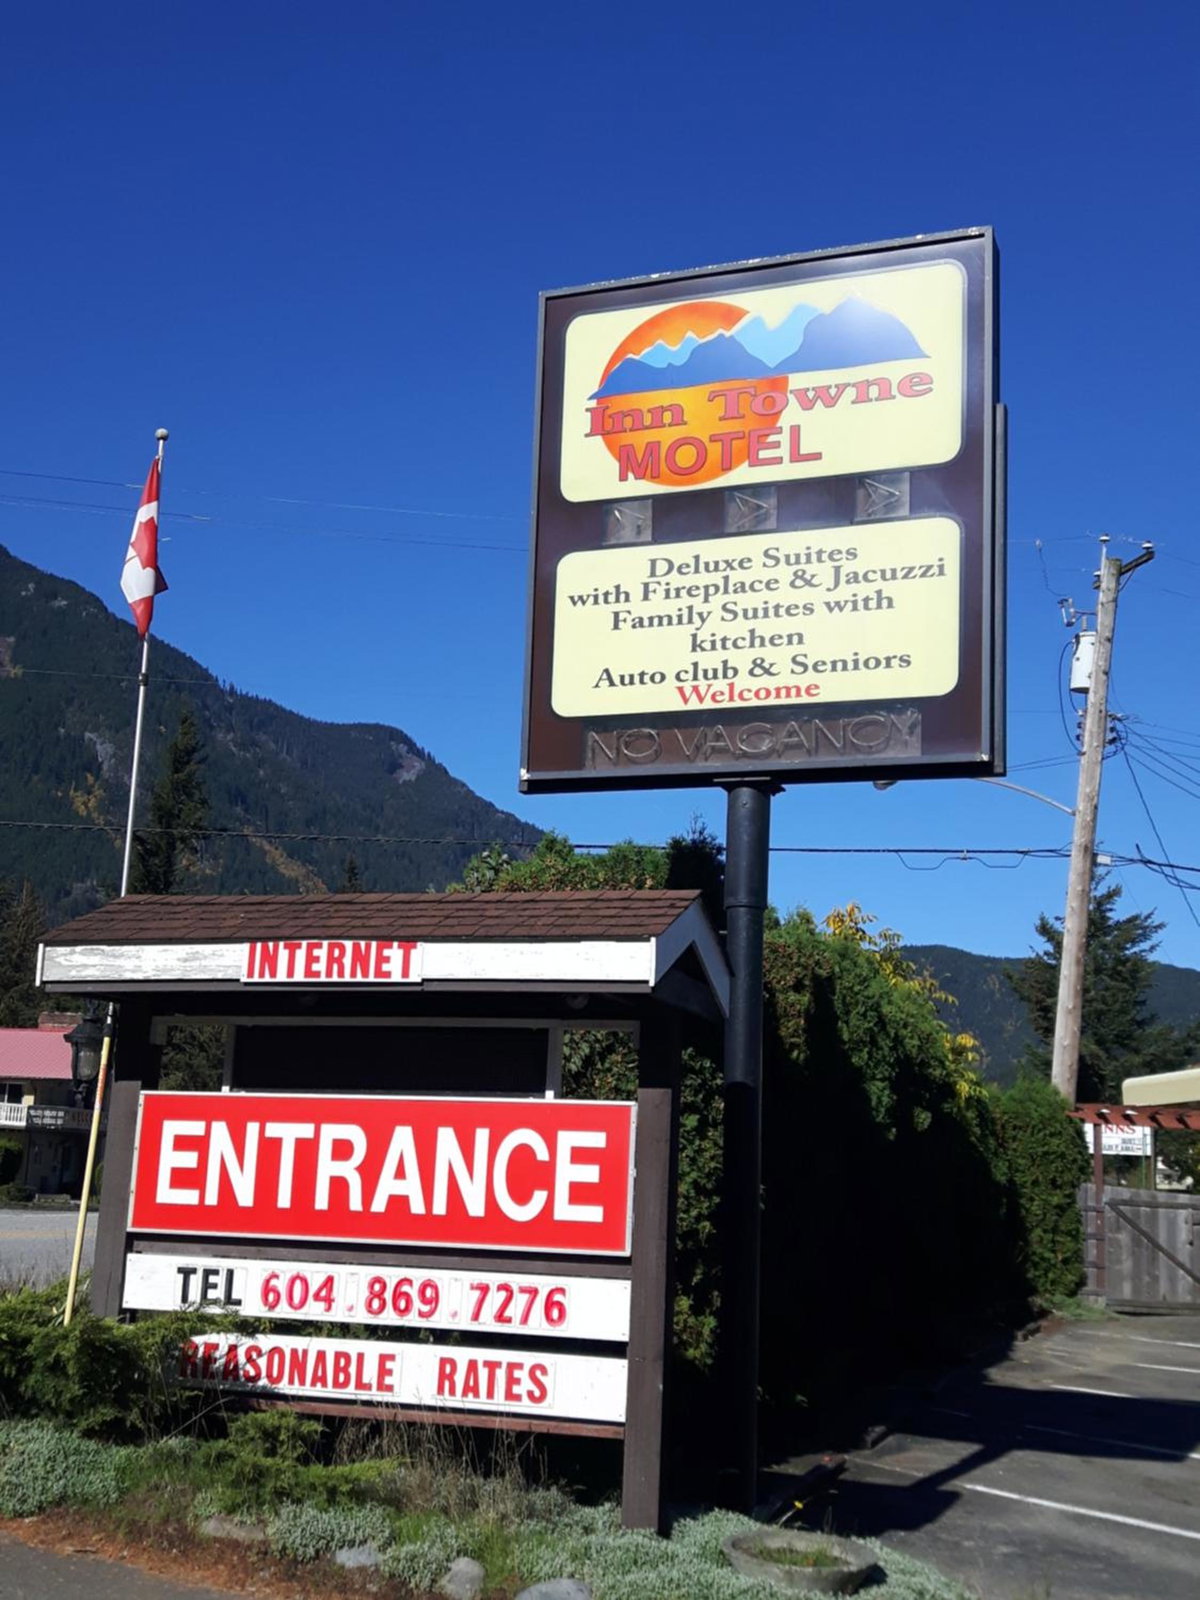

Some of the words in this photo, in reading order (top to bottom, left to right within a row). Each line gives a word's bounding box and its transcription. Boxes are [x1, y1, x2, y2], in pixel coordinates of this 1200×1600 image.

[584, 403, 687, 437] Inn
[707, 371, 935, 422] Towne
[618, 424, 822, 482] MOTEL
[568, 585, 631, 607] with
[640, 573, 780, 603] Fireplace
[789, 568, 822, 589] &
[826, 557, 947, 592] Jacuzzi
[647, 555, 754, 579] Deluxe
[762, 545, 858, 569] Suites
[611, 603, 711, 631] Family
[720, 599, 815, 623] Suites
[823, 590, 895, 613] with
[689, 629, 805, 653] kitchen
[592, 667, 666, 688] Auto
[675, 660, 739, 683] club
[747, 657, 780, 677] &
[790, 650, 912, 676] Seniors
[676, 680, 821, 706] Welcome
[587, 727, 662, 768] NO
[246, 941, 418, 979] INTERNET
[155, 1120, 608, 1223] ENTRANCE
[176, 1267, 243, 1306] TEL
[179, 1339, 397, 1393] REASONABLE
[437, 1356, 550, 1405] RATES
